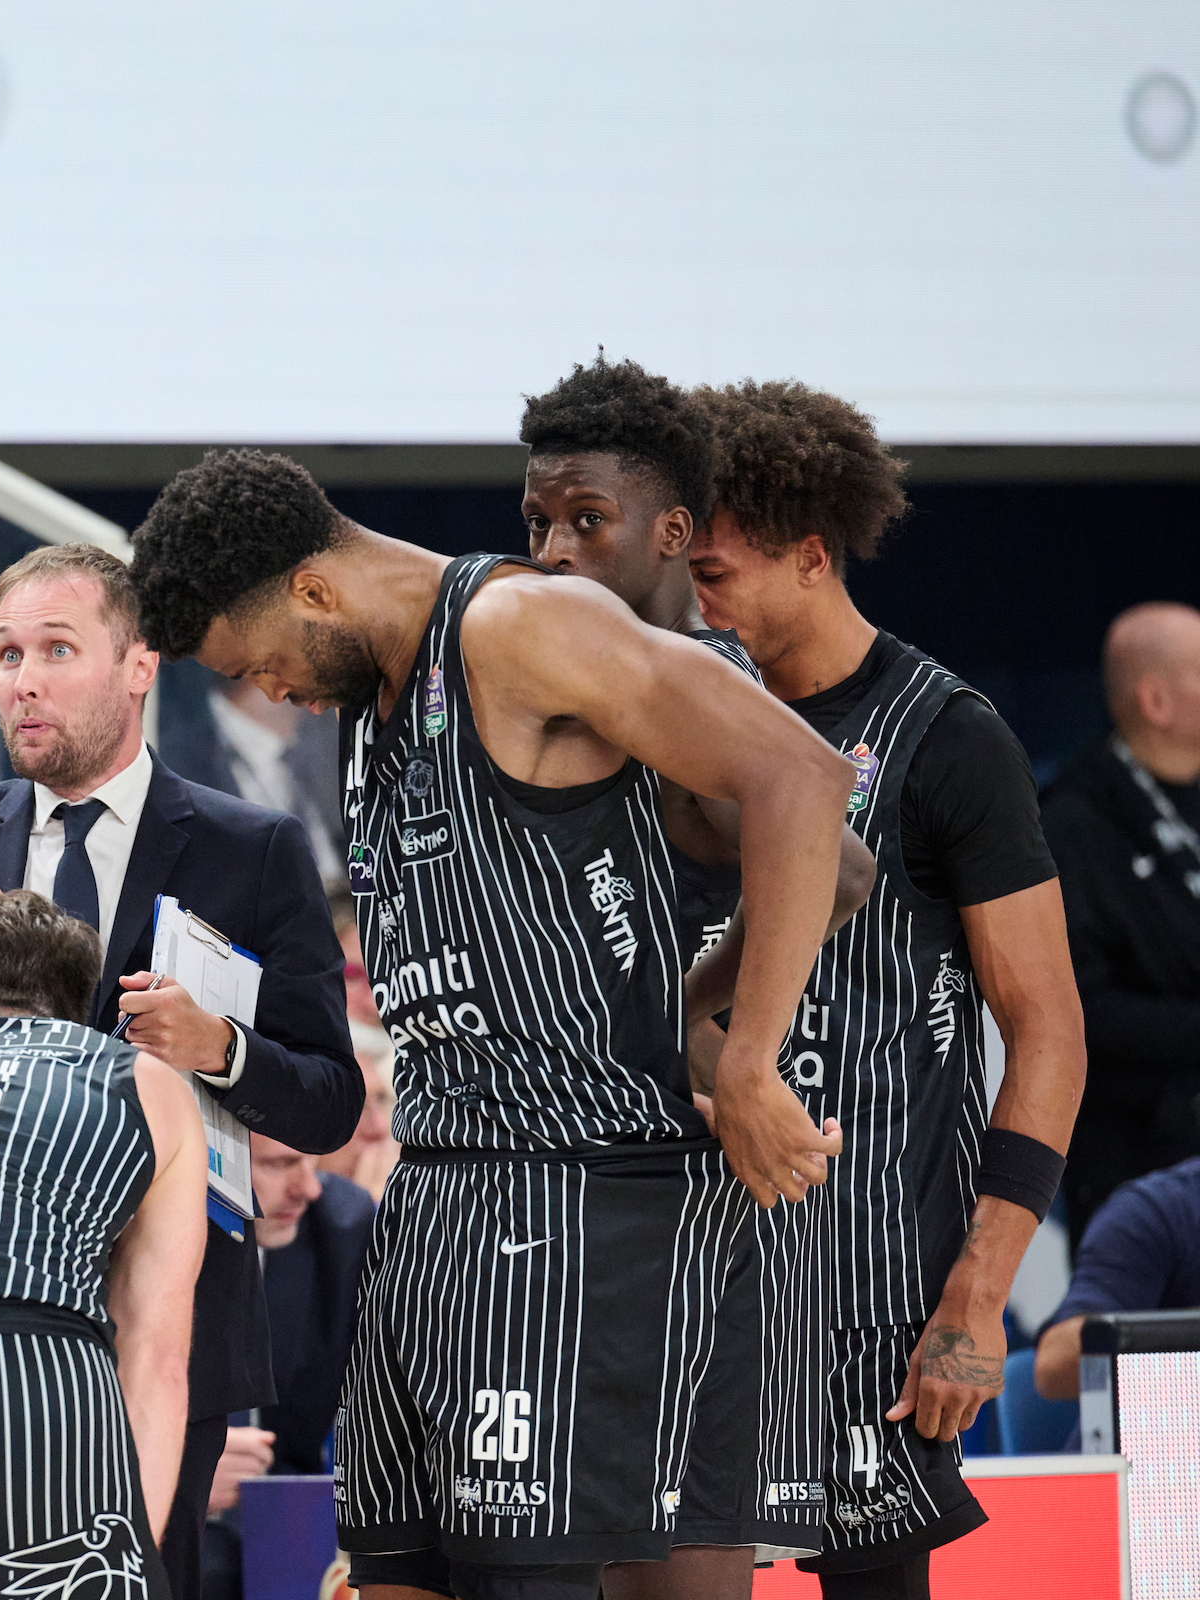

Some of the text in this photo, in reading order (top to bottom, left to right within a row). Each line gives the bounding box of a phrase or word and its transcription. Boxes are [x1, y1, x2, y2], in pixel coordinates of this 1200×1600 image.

[425, 691, 442, 707] LBA
[583, 847, 639, 974] TRENTIN
[472, 1389, 532, 1462] 26
[850, 1425, 880, 1489] 4
[485, 1479, 547, 1506] ITAS
[780, 1482, 808, 1501] BTS
[484, 1504, 531, 1517] MUTUA
